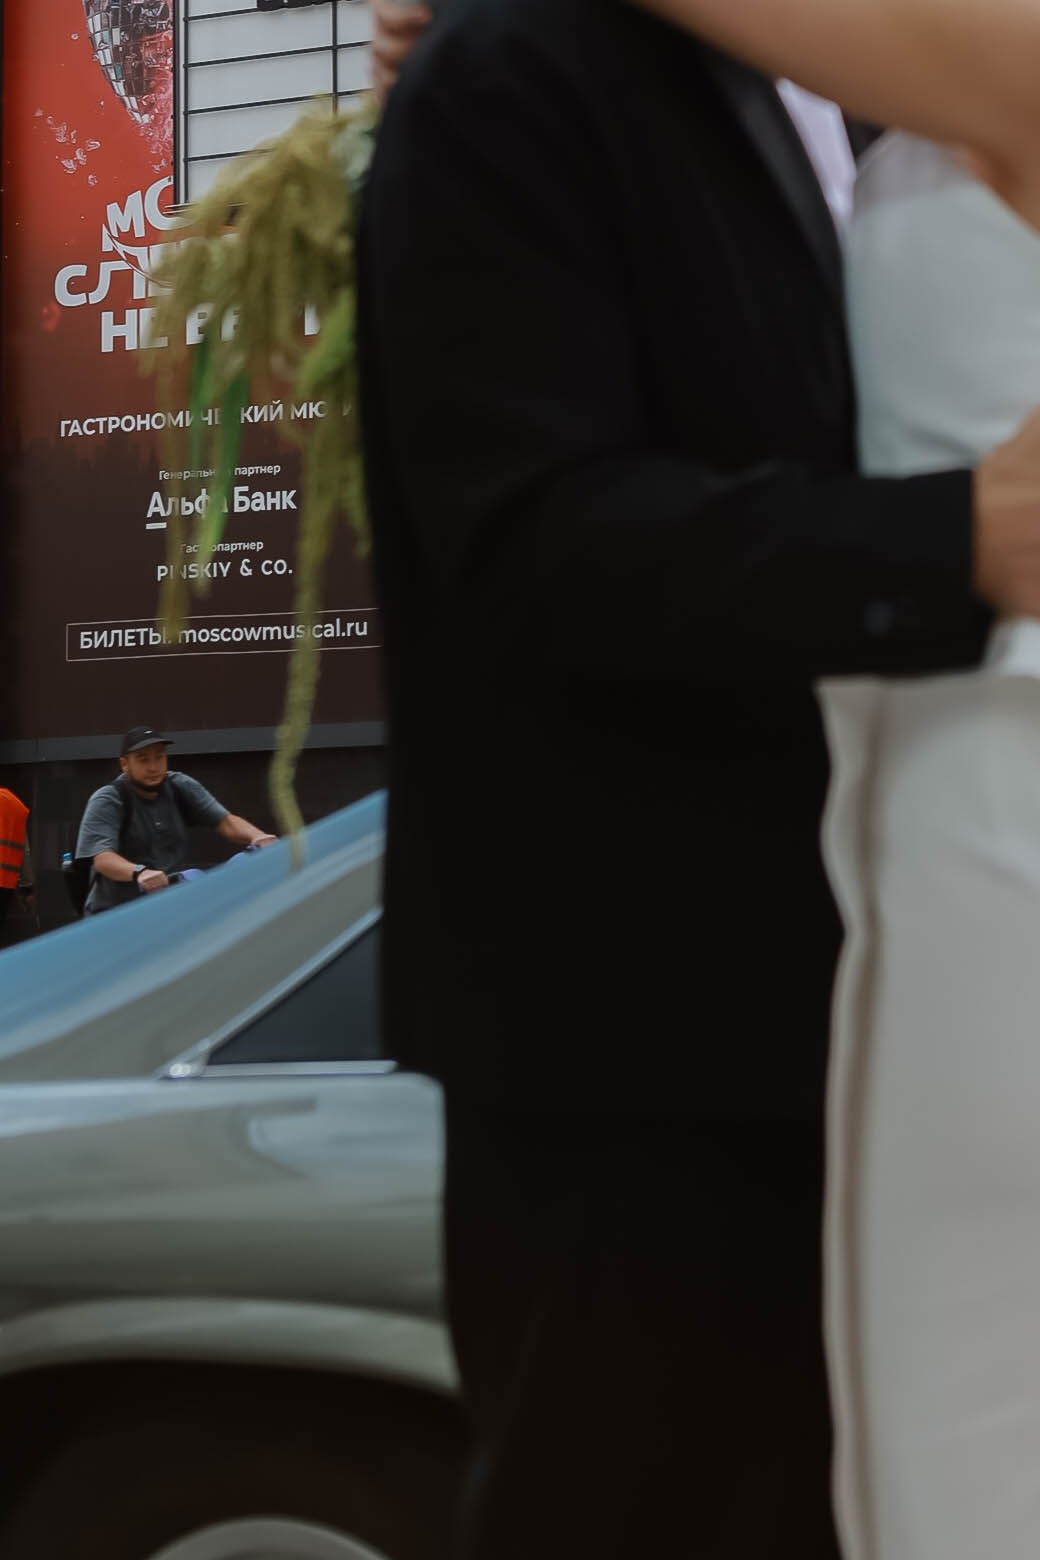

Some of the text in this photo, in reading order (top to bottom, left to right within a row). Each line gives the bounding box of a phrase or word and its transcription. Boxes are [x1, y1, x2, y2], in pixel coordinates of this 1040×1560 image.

[234, 464, 281, 477] партнер
[239, 558, 253, 577] &
[178, 618, 368, 645] moscowmuscal.ru
